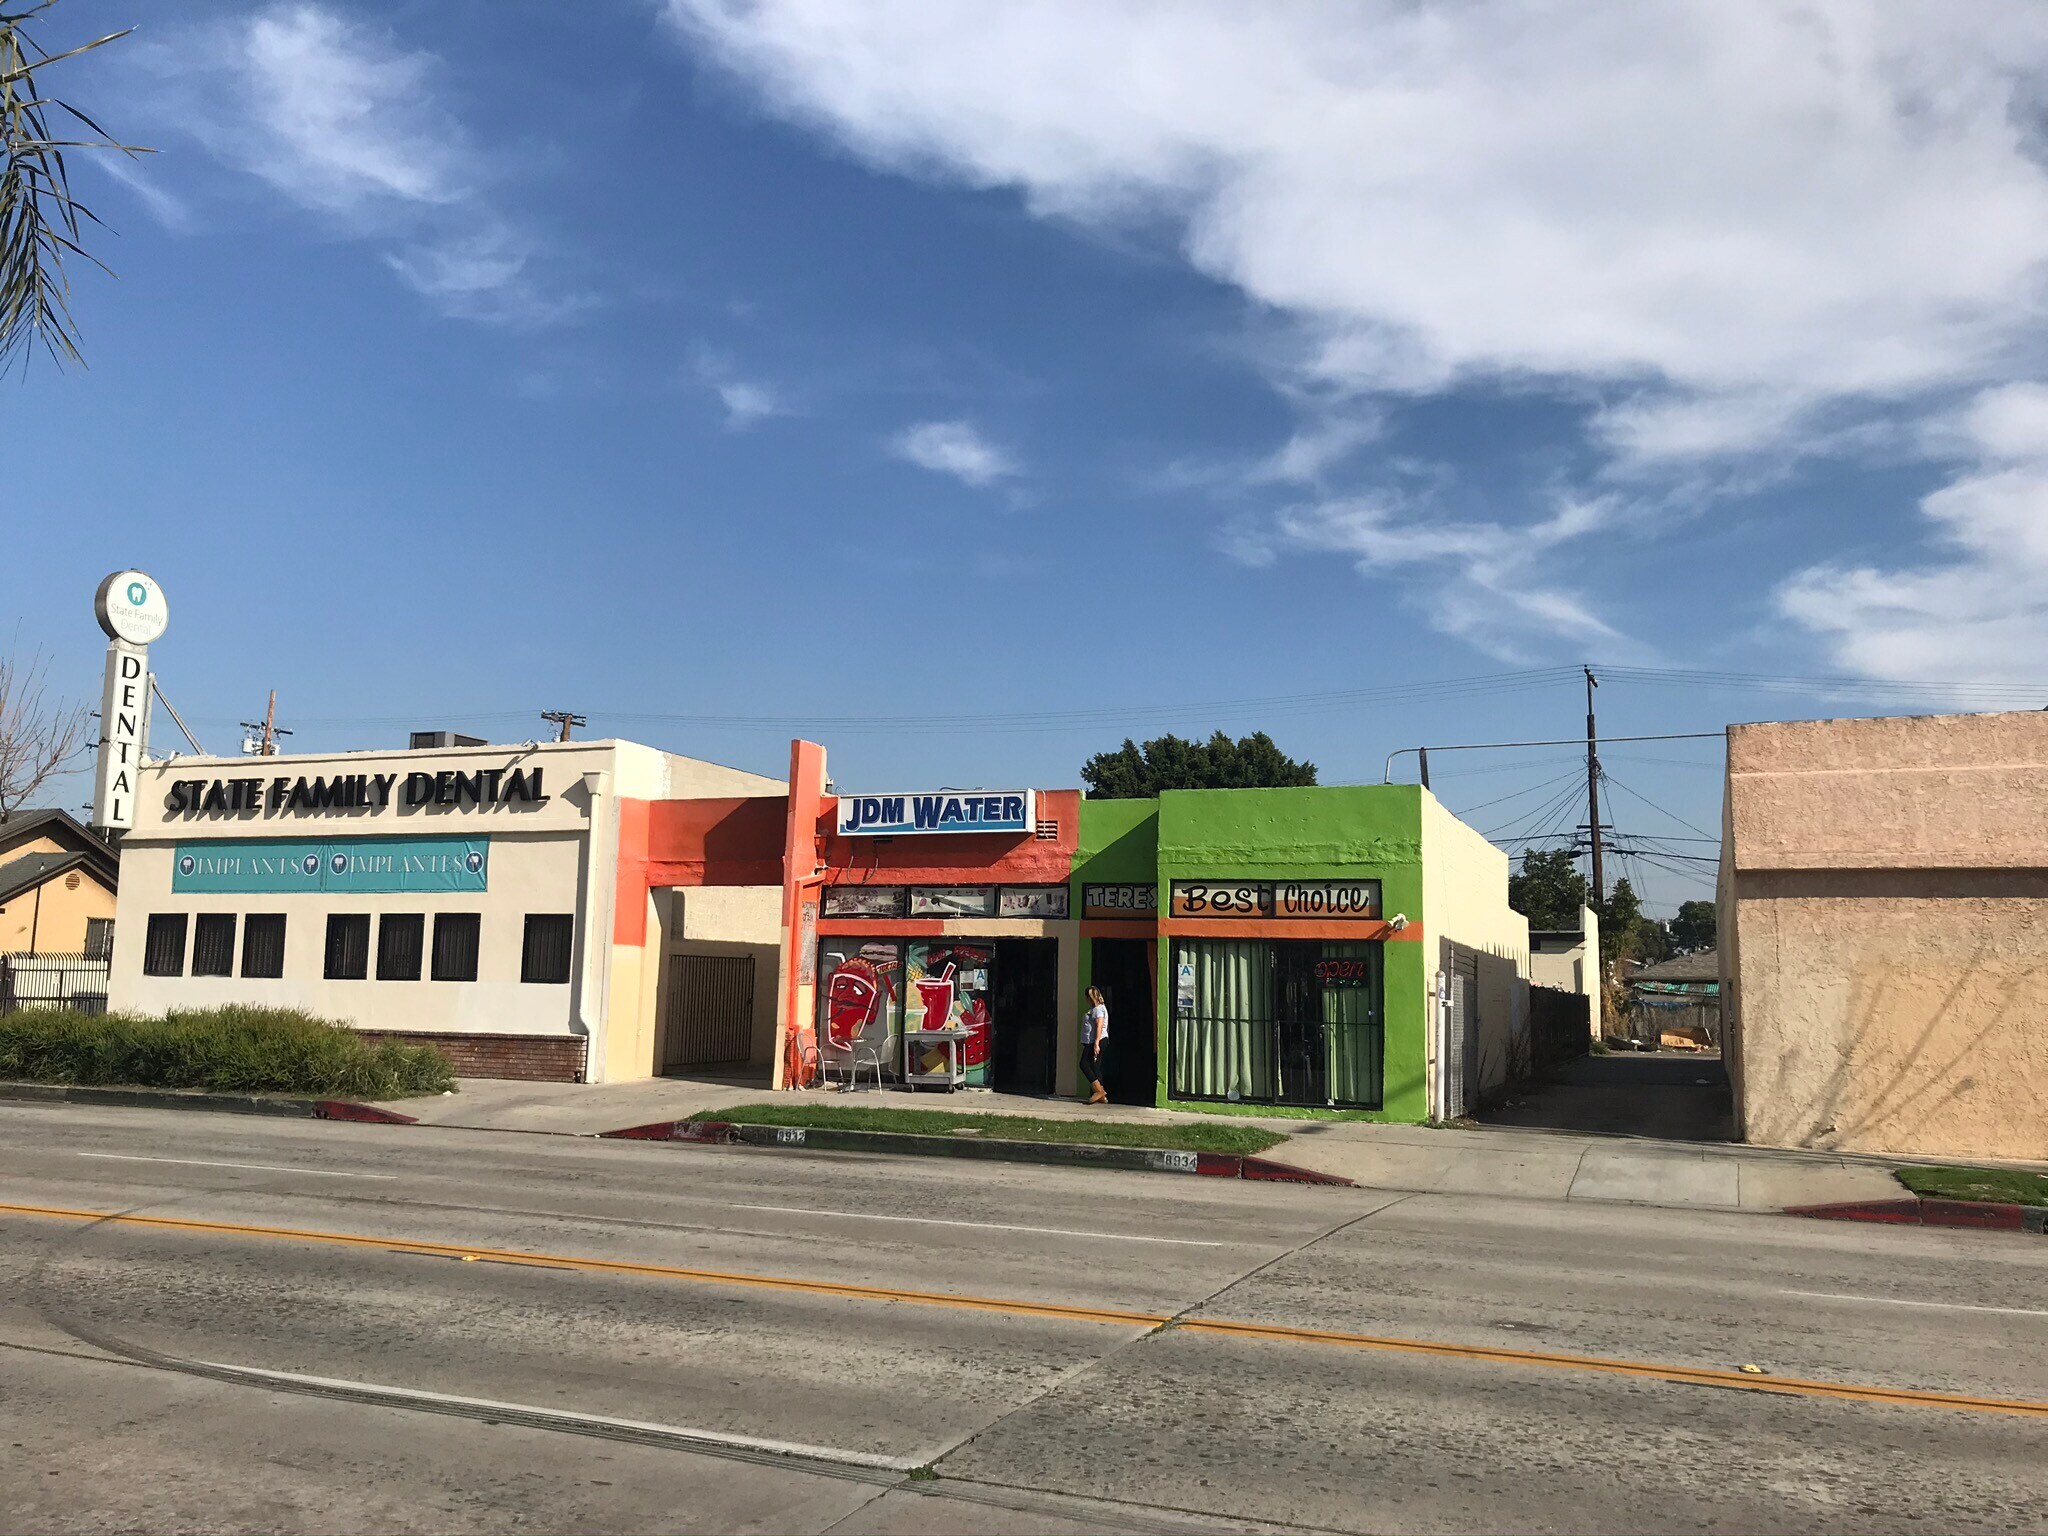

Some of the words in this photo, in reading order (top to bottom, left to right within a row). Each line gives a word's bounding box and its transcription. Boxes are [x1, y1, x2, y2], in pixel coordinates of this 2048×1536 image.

[111, 603, 133, 618] State
[134, 609, 163, 627] Family
[120, 619, 151, 635] Dental
[112, 656, 141, 821] DENTAL
[169, 778, 265, 812] STATE
[272, 773, 398, 810] FAMILY
[405, 767, 551, 805] DENTAL
[845, 797, 906, 832] JDM
[912, 795, 1025, 830] WATER
[198, 857, 300, 876] IMPLANTS
[350, 854, 464, 874] IMPLANTES
[1181, 884, 1271, 913] Best
[1284, 883, 1370, 914] Choice
[976, 970, 985, 980] A
[1181, 965, 1191, 976] A
[1165, 1154, 1197, 1168] 8934
